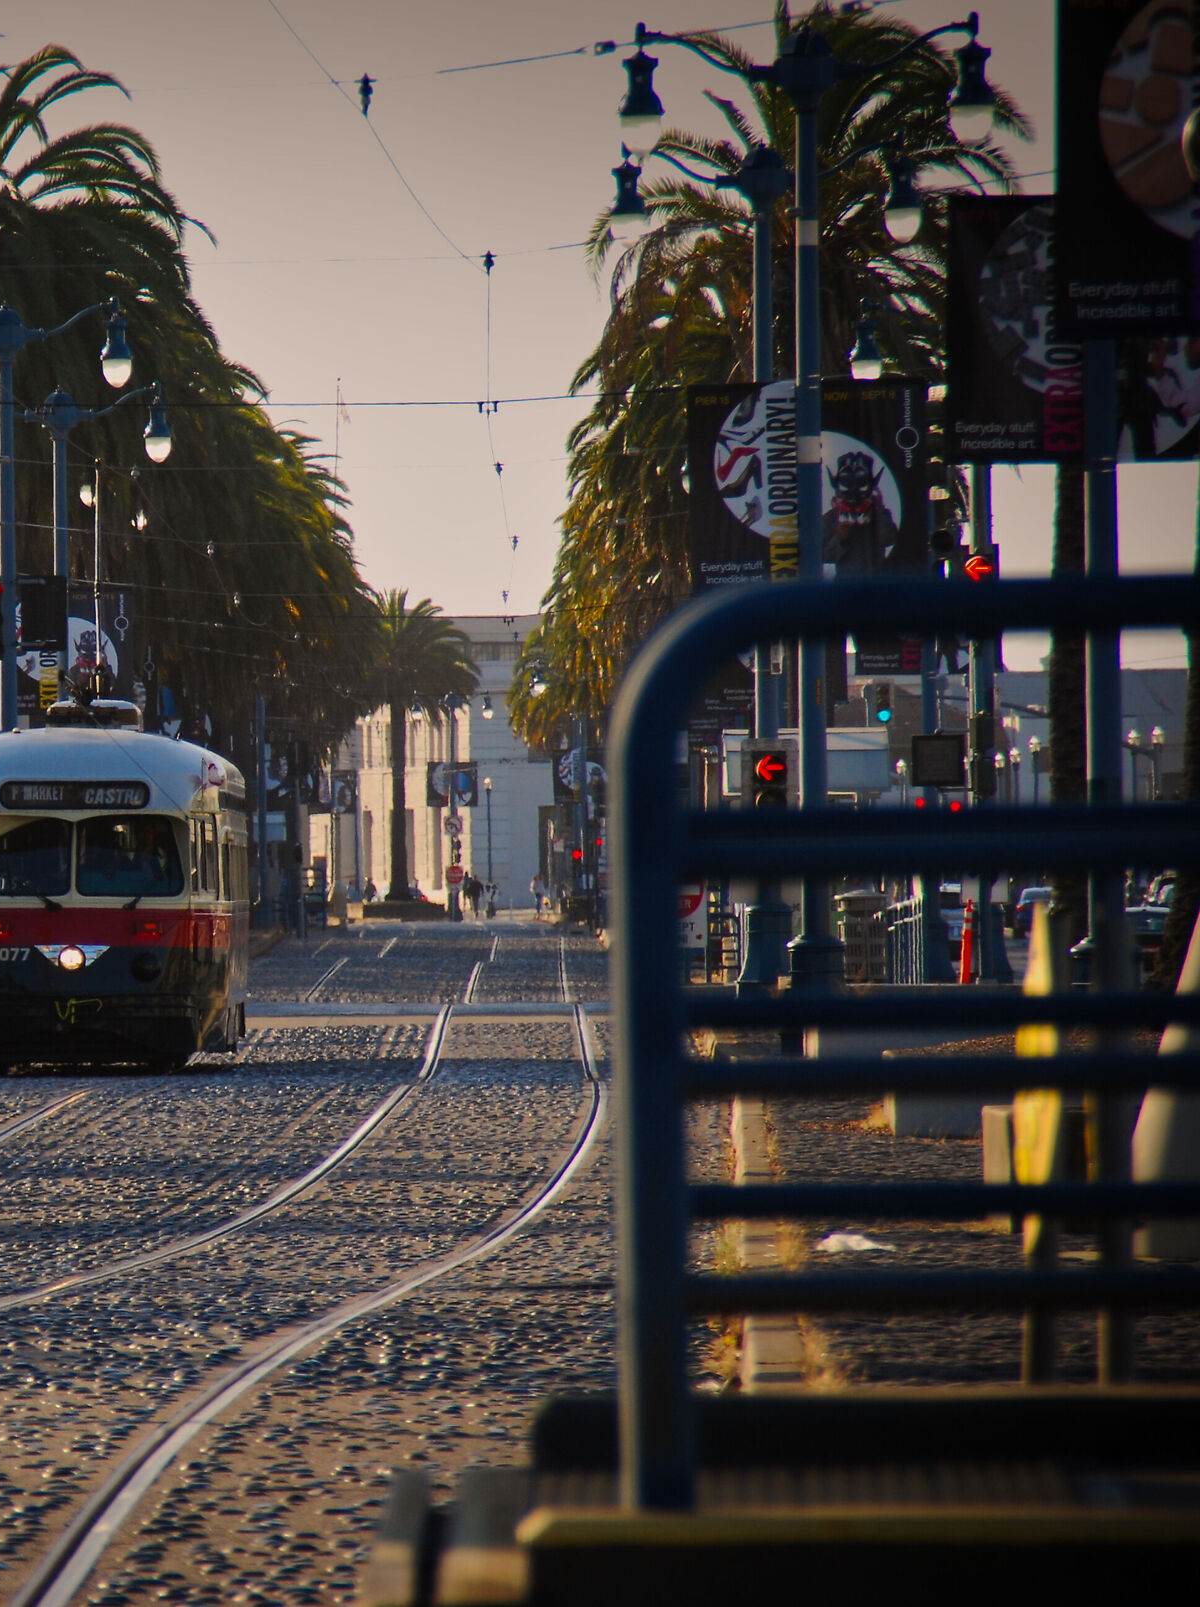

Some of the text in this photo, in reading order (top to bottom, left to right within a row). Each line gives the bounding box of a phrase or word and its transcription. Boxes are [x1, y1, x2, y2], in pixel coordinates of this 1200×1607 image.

[1067, 282, 1140, 300] Everyday
[1076, 303, 1150, 320] Incredible
[823, 391, 849, 401] NOW
[954, 420, 1038, 436] Everyday stuff.
[960, 438, 1015, 449] Incredible
[23, 785, 63, 801] MARKET
